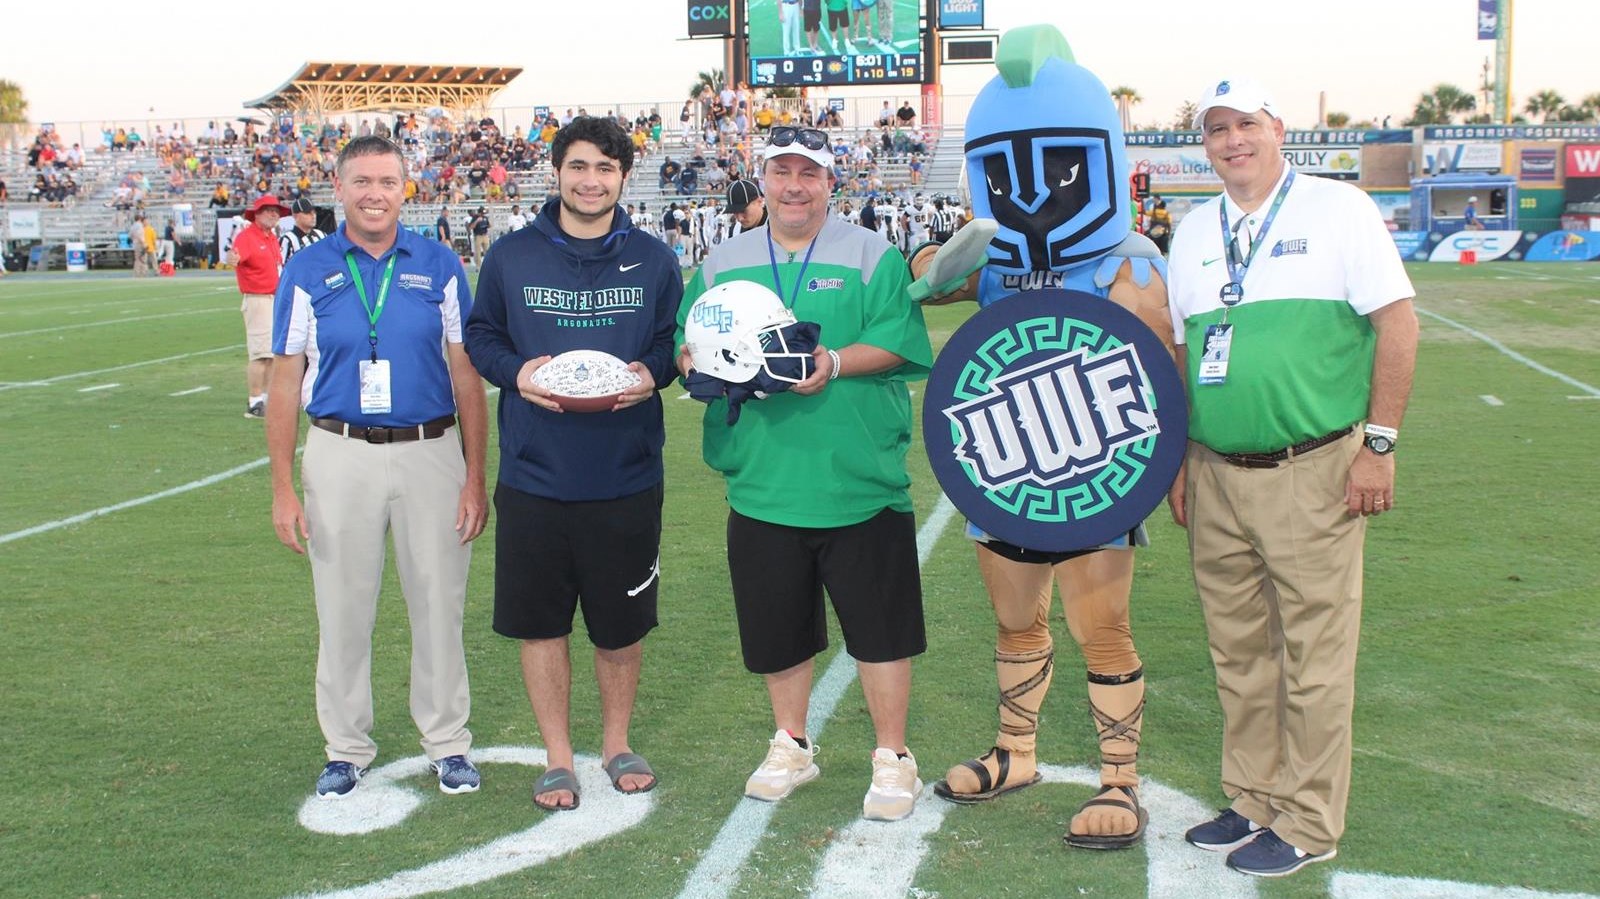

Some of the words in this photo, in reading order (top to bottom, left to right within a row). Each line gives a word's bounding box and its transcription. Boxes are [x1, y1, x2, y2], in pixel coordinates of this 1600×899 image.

[690, 5, 729, 20] COX
[943, 3, 978, 13] LIGHT
[856, 54, 882, 66] 6:01
[894, 53, 901, 66] 1
[783, 60, 794, 73] 0
[812, 60, 823, 73] 0
[871, 68, 884, 78] 10
[901, 67, 914, 77] 19
[767, 74, 775, 84] 2
[814, 73, 822, 82] 3
[1434, 128, 1514, 138] ARGONAUT
[1525, 127, 1598, 137] FOOTBALL
[1124, 135, 1164, 144] NAUT
[1280, 151, 1327, 166] RULY
[1136, 159, 1180, 174] Coors
[1182, 163, 1214, 173] LIGH
[524, 287, 572, 310] WEST
[573, 287, 644, 311] FLORIDA
[557, 317, 613, 328] ARGONAUTS
[693, 301, 734, 333] UWF
[965, 358, 1157, 479] UWF
